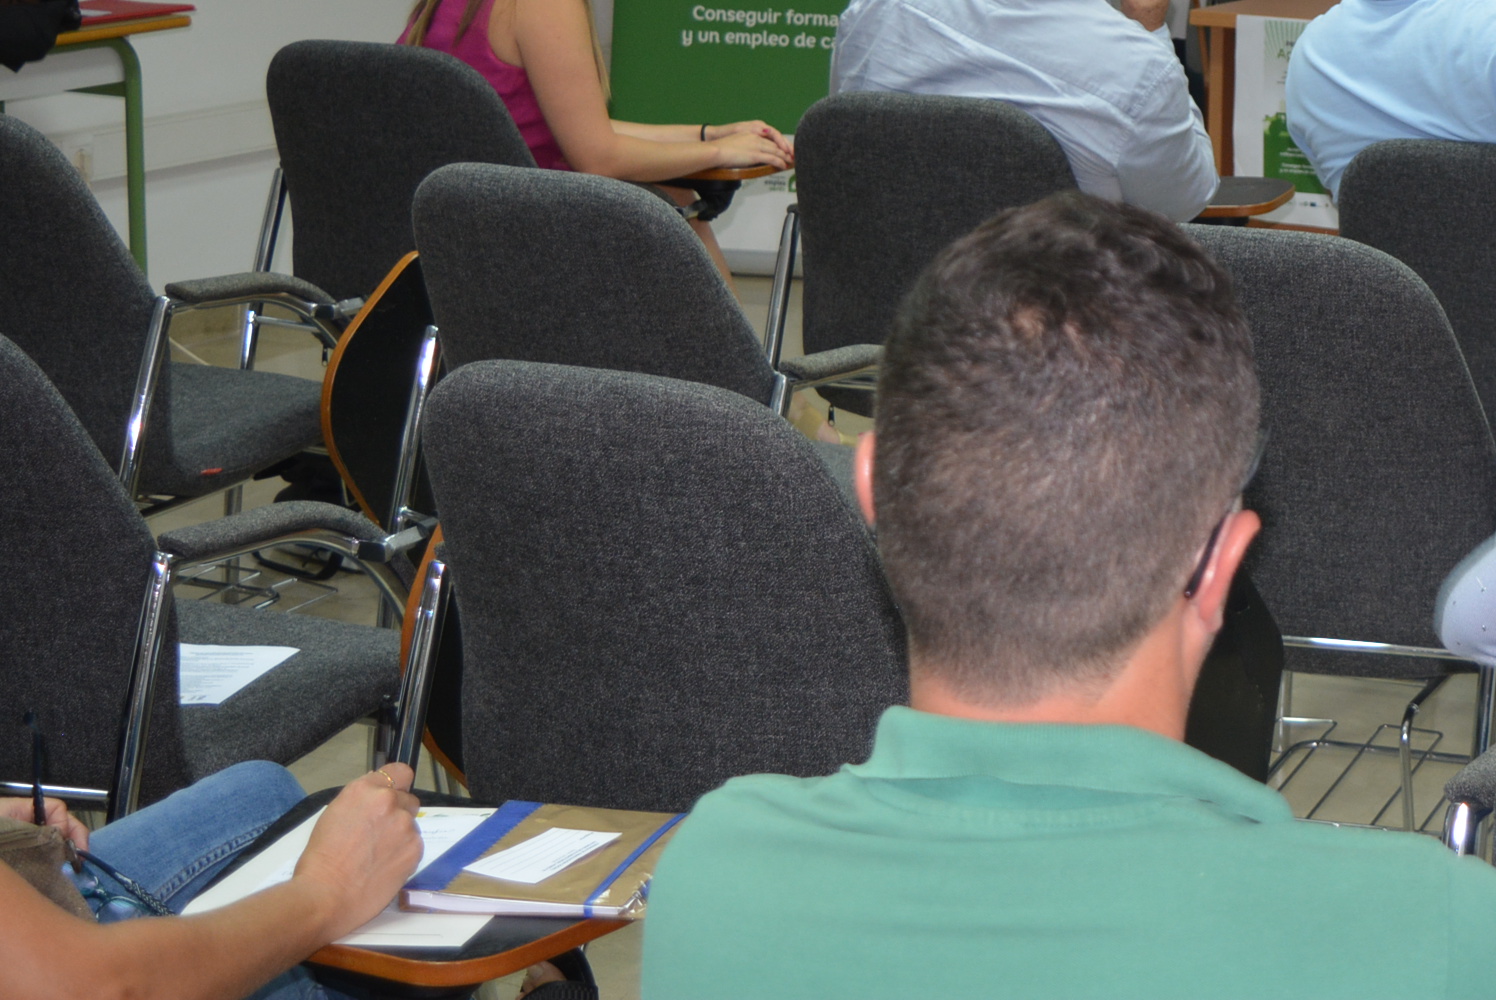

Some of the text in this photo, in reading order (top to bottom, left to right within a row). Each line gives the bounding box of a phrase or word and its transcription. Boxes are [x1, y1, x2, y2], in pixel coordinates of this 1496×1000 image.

[692, 5, 839, 28] Conseguir forma
[682, 30, 693, 46] y
[698, 30, 720, 44] un
[725, 30, 789, 49] empleo
[794, 31, 816, 48] de
